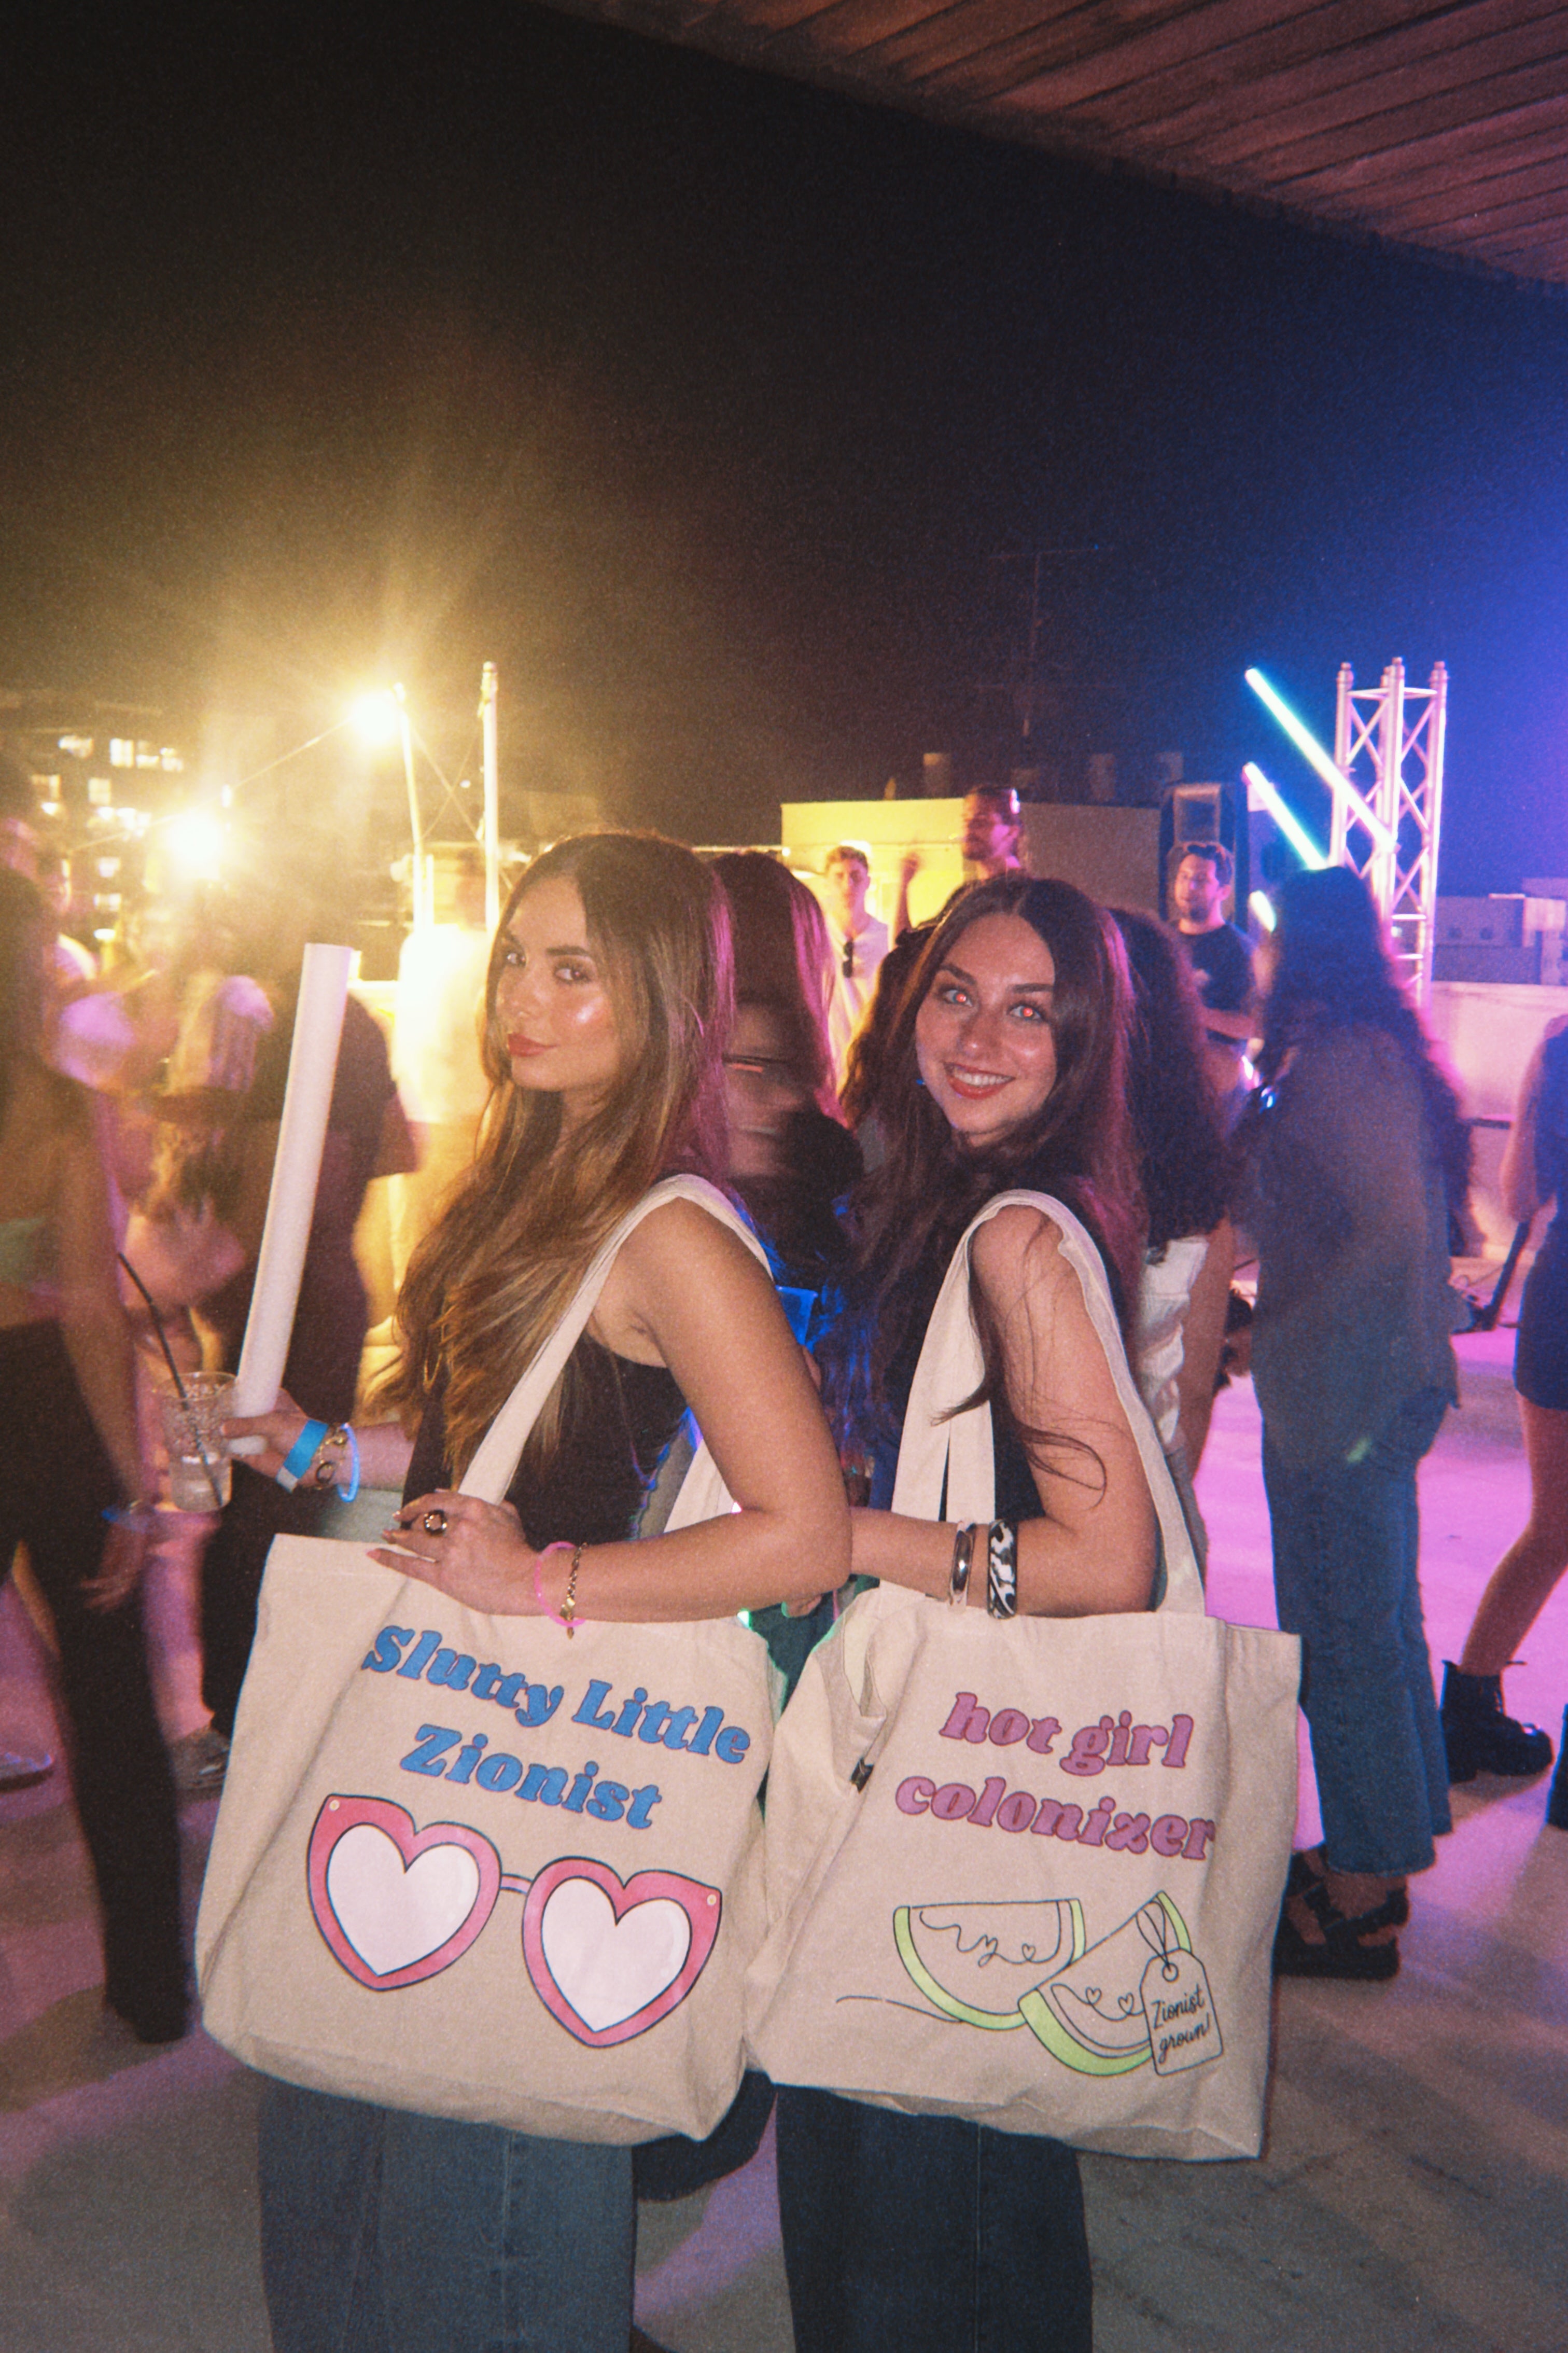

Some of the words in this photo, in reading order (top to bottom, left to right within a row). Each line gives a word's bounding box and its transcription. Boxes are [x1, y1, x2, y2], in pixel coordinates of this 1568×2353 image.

[361, 1625, 564, 1728] Slutty
[572, 1679, 750, 1763] Little
[939, 1692, 1062, 1754] hot
[1059, 1710, 1194, 1776] girl
[400, 1723, 662, 1829] Zionist
[895, 1776, 1216, 1860] colonizer
[1151, 1983, 1206, 2030] Zionist
[1157, 2012, 1210, 2065] grown
